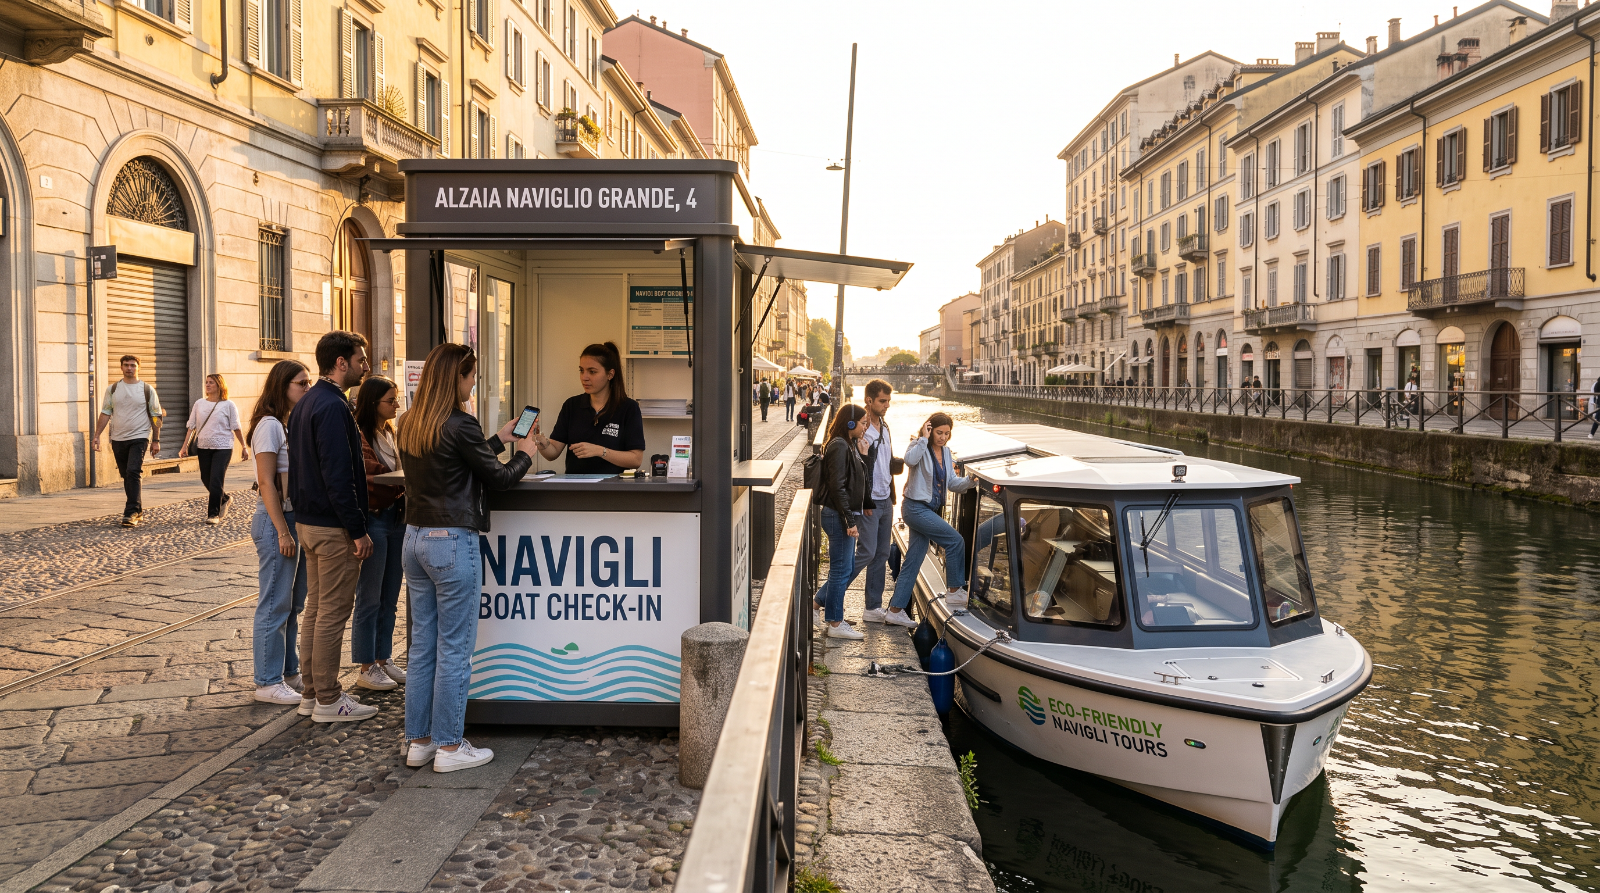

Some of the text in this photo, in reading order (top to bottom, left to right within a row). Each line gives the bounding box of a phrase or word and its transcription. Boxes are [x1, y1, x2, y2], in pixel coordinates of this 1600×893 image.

[435, 187, 697, 212] ALZAIA NAVIGLIO GRANDE, 4
[478, 535, 662, 588] NAVIGLI
[478, 592, 662, 622] BOAT CHECK-IN
[1048, 697, 1162, 738] ECO-FRIENDLY
[1051, 714, 1168, 758] NAVIGLI TOURS
